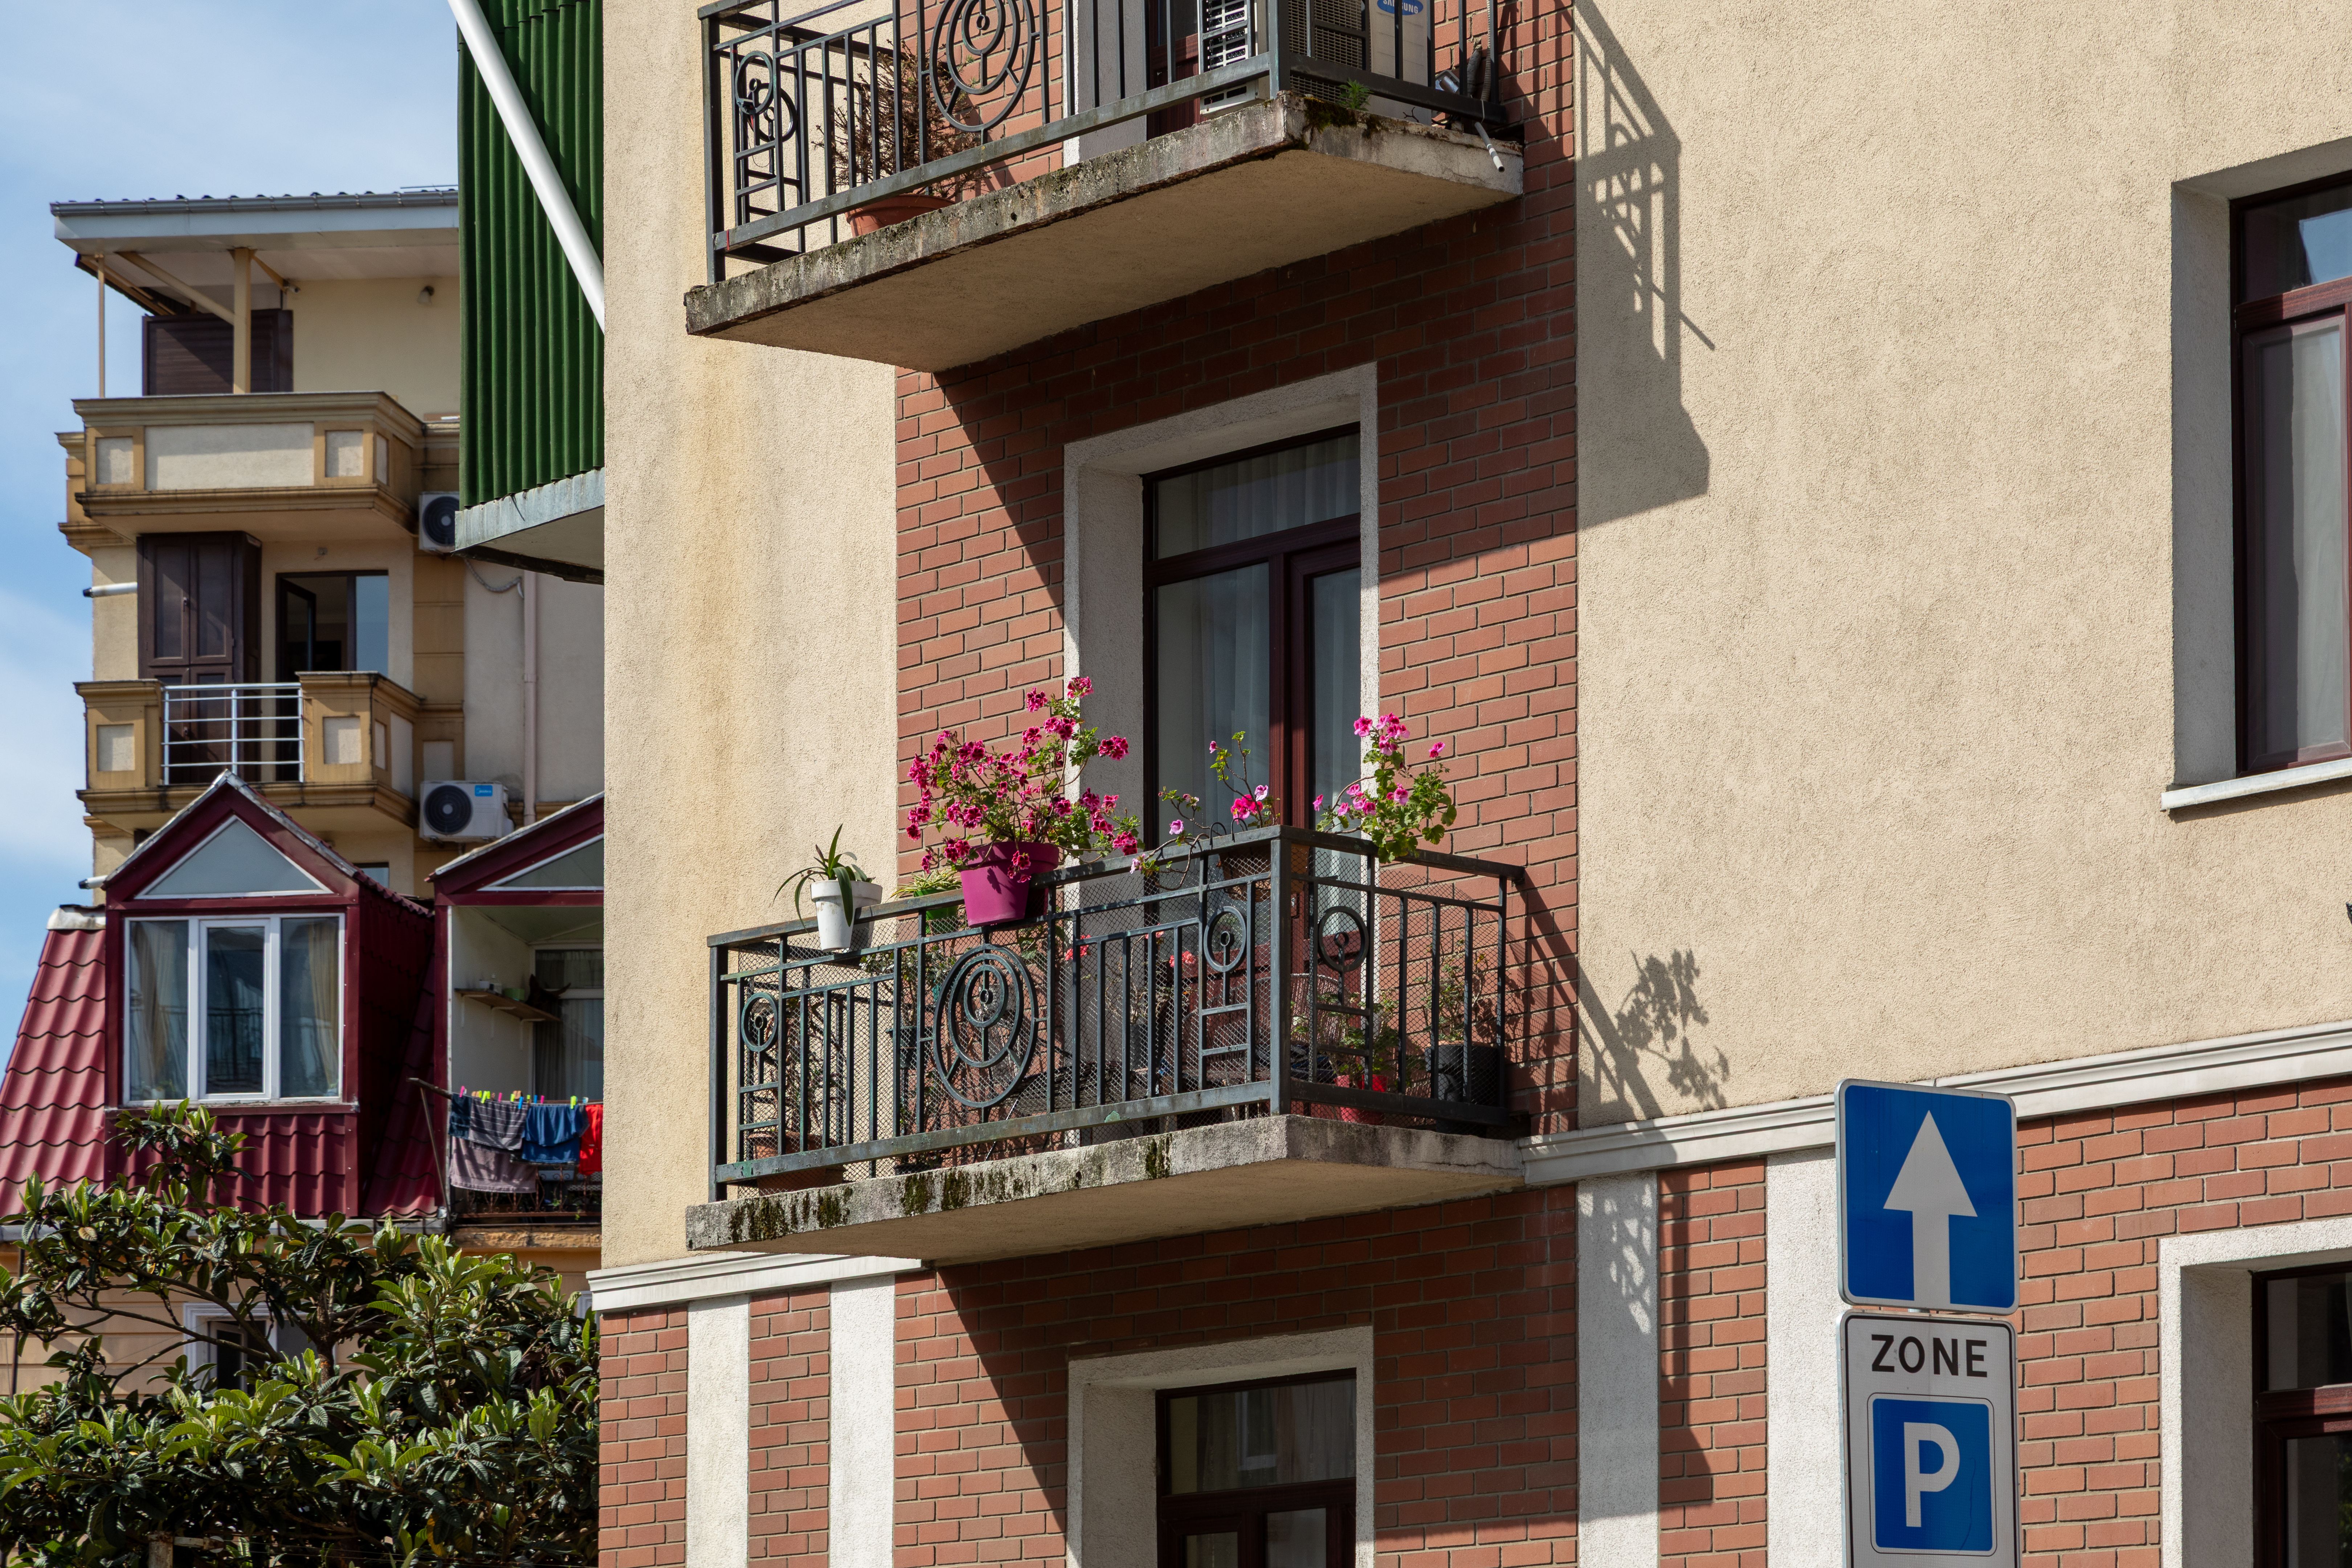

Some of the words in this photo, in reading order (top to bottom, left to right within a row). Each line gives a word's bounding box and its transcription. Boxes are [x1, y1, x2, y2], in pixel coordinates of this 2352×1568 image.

[1383, 0, 1418, 14] SAUNG
[1871, 1334, 1988, 1378] ZONE
[1904, 1422, 1960, 1527] P
